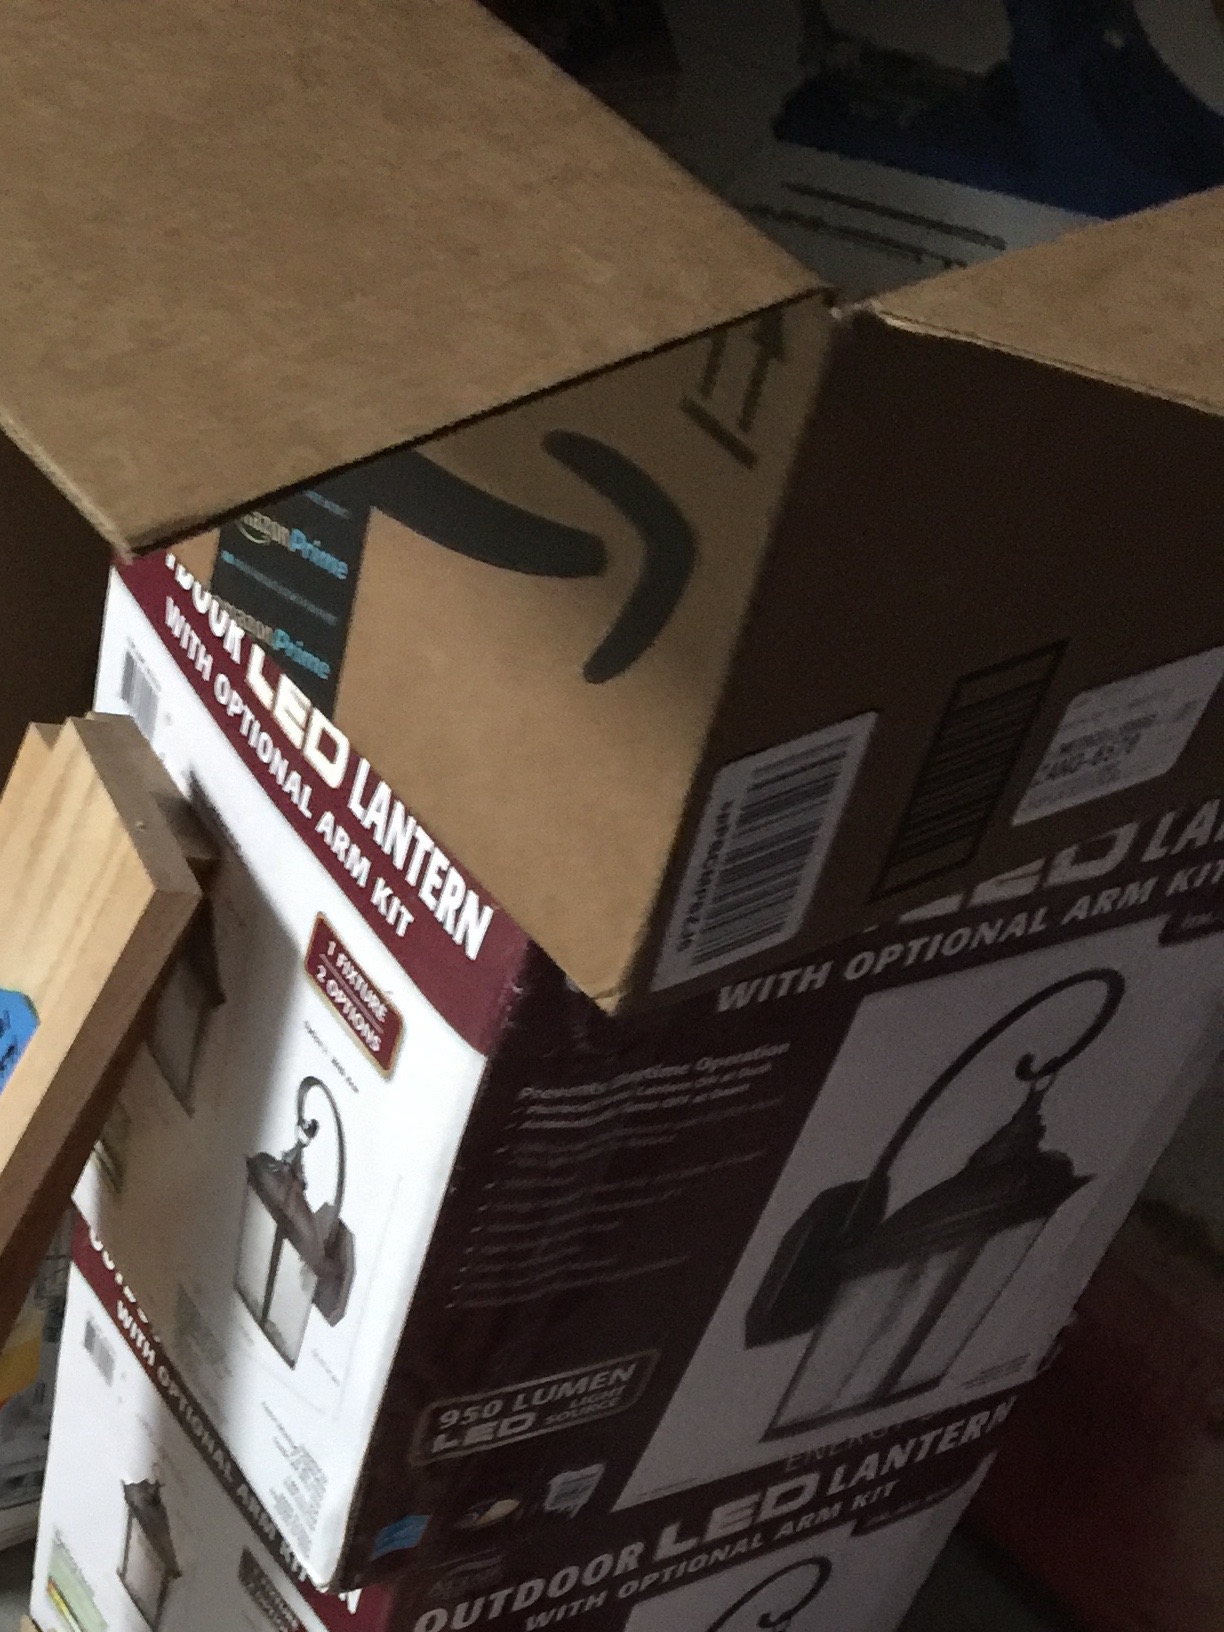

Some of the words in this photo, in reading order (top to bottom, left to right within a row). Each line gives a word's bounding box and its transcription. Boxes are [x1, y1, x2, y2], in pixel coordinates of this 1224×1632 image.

[165, 597, 214, 681] WITH
[214, 674, 312, 818] OPTIONAL
[315, 811, 371, 888] ARM
[370, 877, 414, 937] KIT
[246, 644, 350, 789] LED
[347, 757, 494, 961] LANTERN
[1140, 798, 1224, 863] LA
[715, 961, 834, 1013] WITH
[843, 906, 1049, 981] OPTIONAL
[1061, 876, 1159, 926] ARM
[1165, 858, 1224, 898] KIT
[326, 979, 382, 1051] OPTIONS
[336, 953, 387, 1022] FIXTURE
[116, 1300, 156, 1366] WITH
[431, 1411, 538, 1453] LED
[438, 1399, 504, 1430] 950
[511, 1362, 638, 1412] LUMEN
[652, 1470, 822, 1563] LED
[825, 1395, 1018, 1496] LANTERN
[525, 1590, 607, 1632] WITH
[617, 1531, 764, 1600] OPTIONAL
[773, 1502, 844, 1542] ARM
[851, 1478, 902, 1511] KIT
